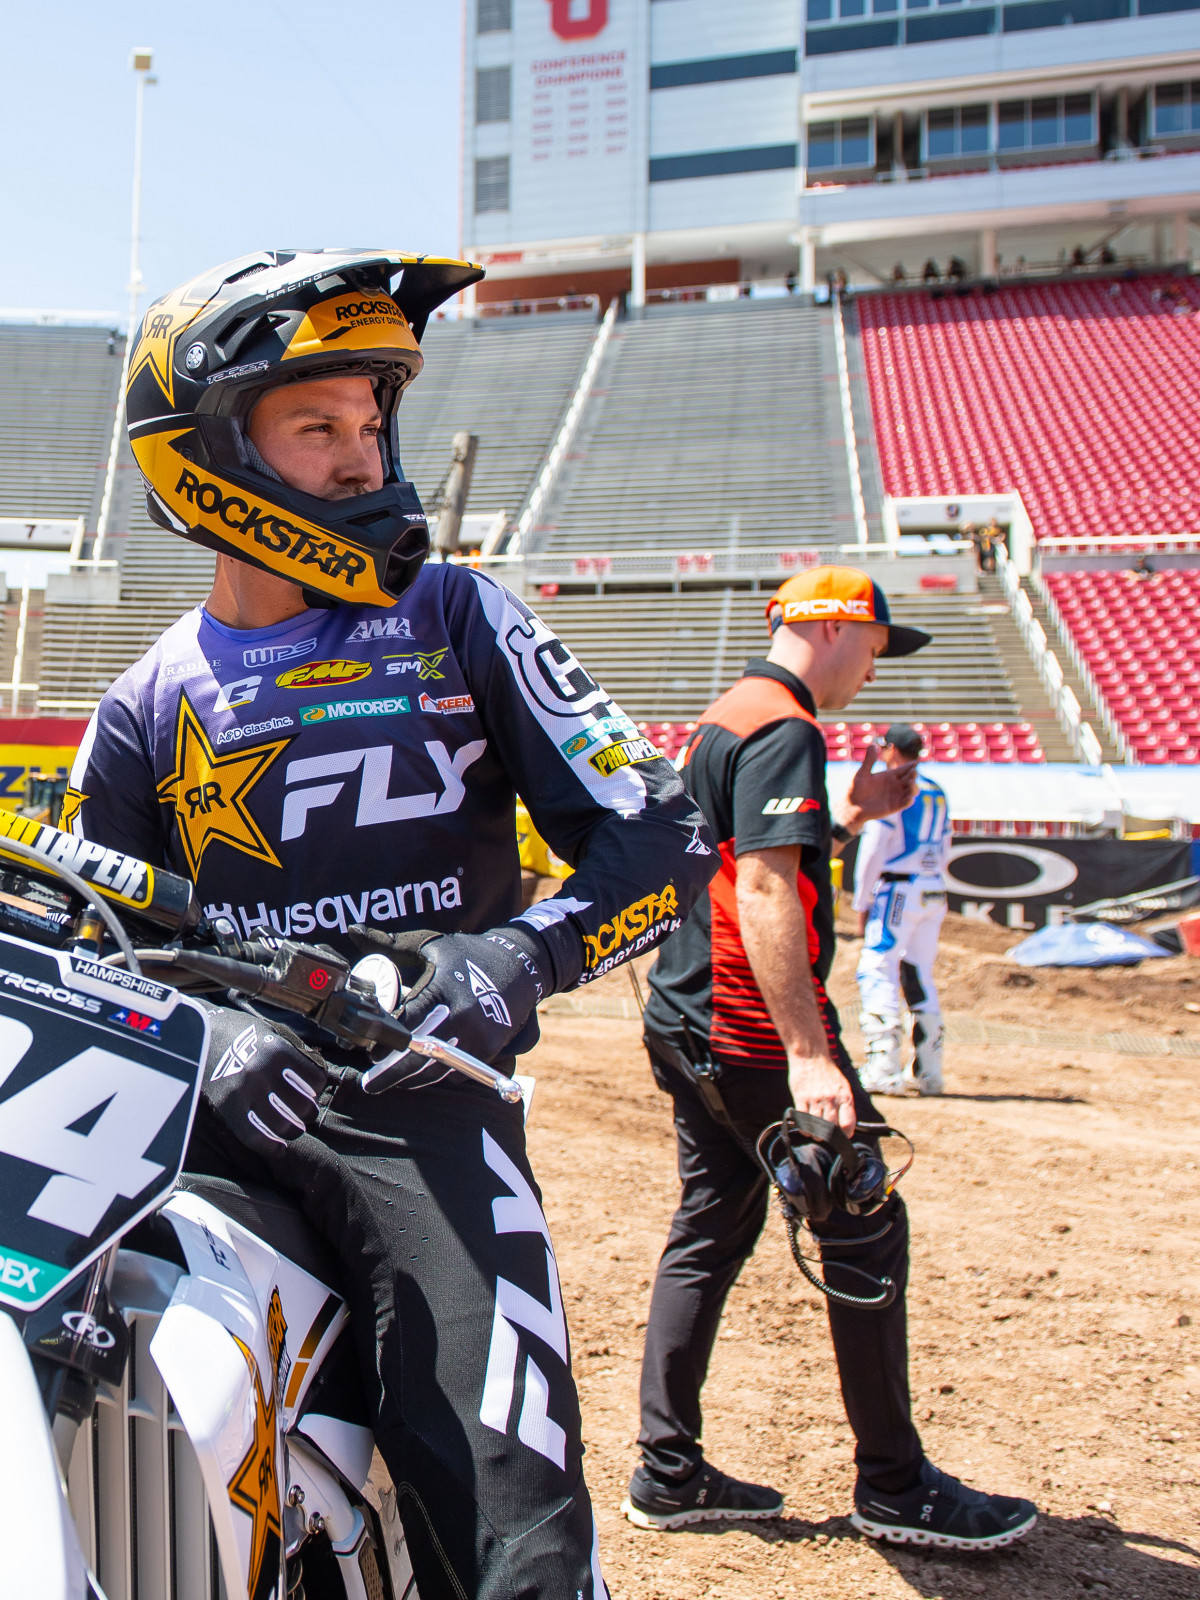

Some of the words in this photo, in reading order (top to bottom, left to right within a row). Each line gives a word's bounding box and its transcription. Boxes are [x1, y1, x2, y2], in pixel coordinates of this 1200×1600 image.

[532, 50, 626, 72] CONFERENCE
[535, 67, 622, 87] CHAMPIONS
[266, 272, 323, 301] RACING
[350, 316, 385, 328] ENERGY
[25, 524, 36, 539] 7
[175, 468, 367, 588] ROCKSTAR
[785, 599, 870, 618] RACING
[345, 617, 413, 640] AMA
[243, 638, 318, 668] WPS
[277, 660, 373, 688] FMF
[328, 698, 407, 719] MOTOREX
[438, 697, 472, 709] KEEN
[217, 727, 243, 745] A&D
[243, 721, 272, 740] Glass
[272, 717, 294, 731] Inc.
[281, 738, 488, 842] FLY
[761, 797, 821, 815] WP
[238, 876, 463, 941] Husqvarna
[487, 935, 516, 950] FLY
[634, 917, 682, 951] DRINK
[517, 952, 538, 976] FLY
[74, 961, 165, 999] HAMPSHIRE
[479, 1127, 568, 1472] FLY
